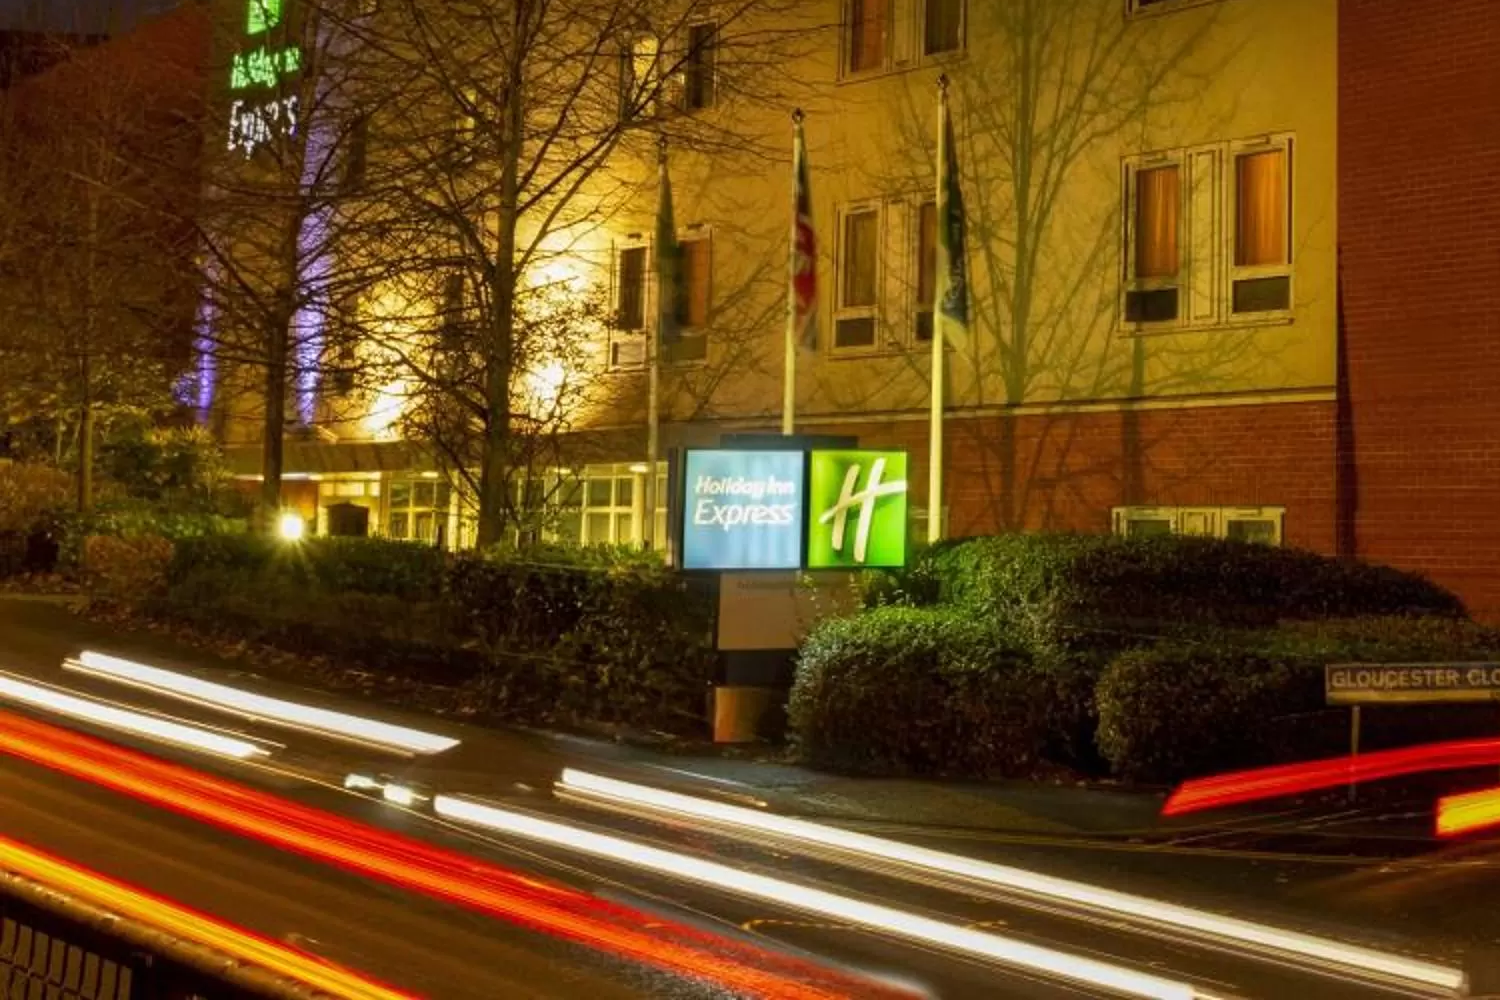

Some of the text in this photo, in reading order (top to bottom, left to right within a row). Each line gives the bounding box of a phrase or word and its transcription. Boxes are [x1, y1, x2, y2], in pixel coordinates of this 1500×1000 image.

[695, 475, 795, 498] Holiday Inn
[693, 500, 795, 531] Express
[1331, 669, 1461, 688] GLOUCESTER
